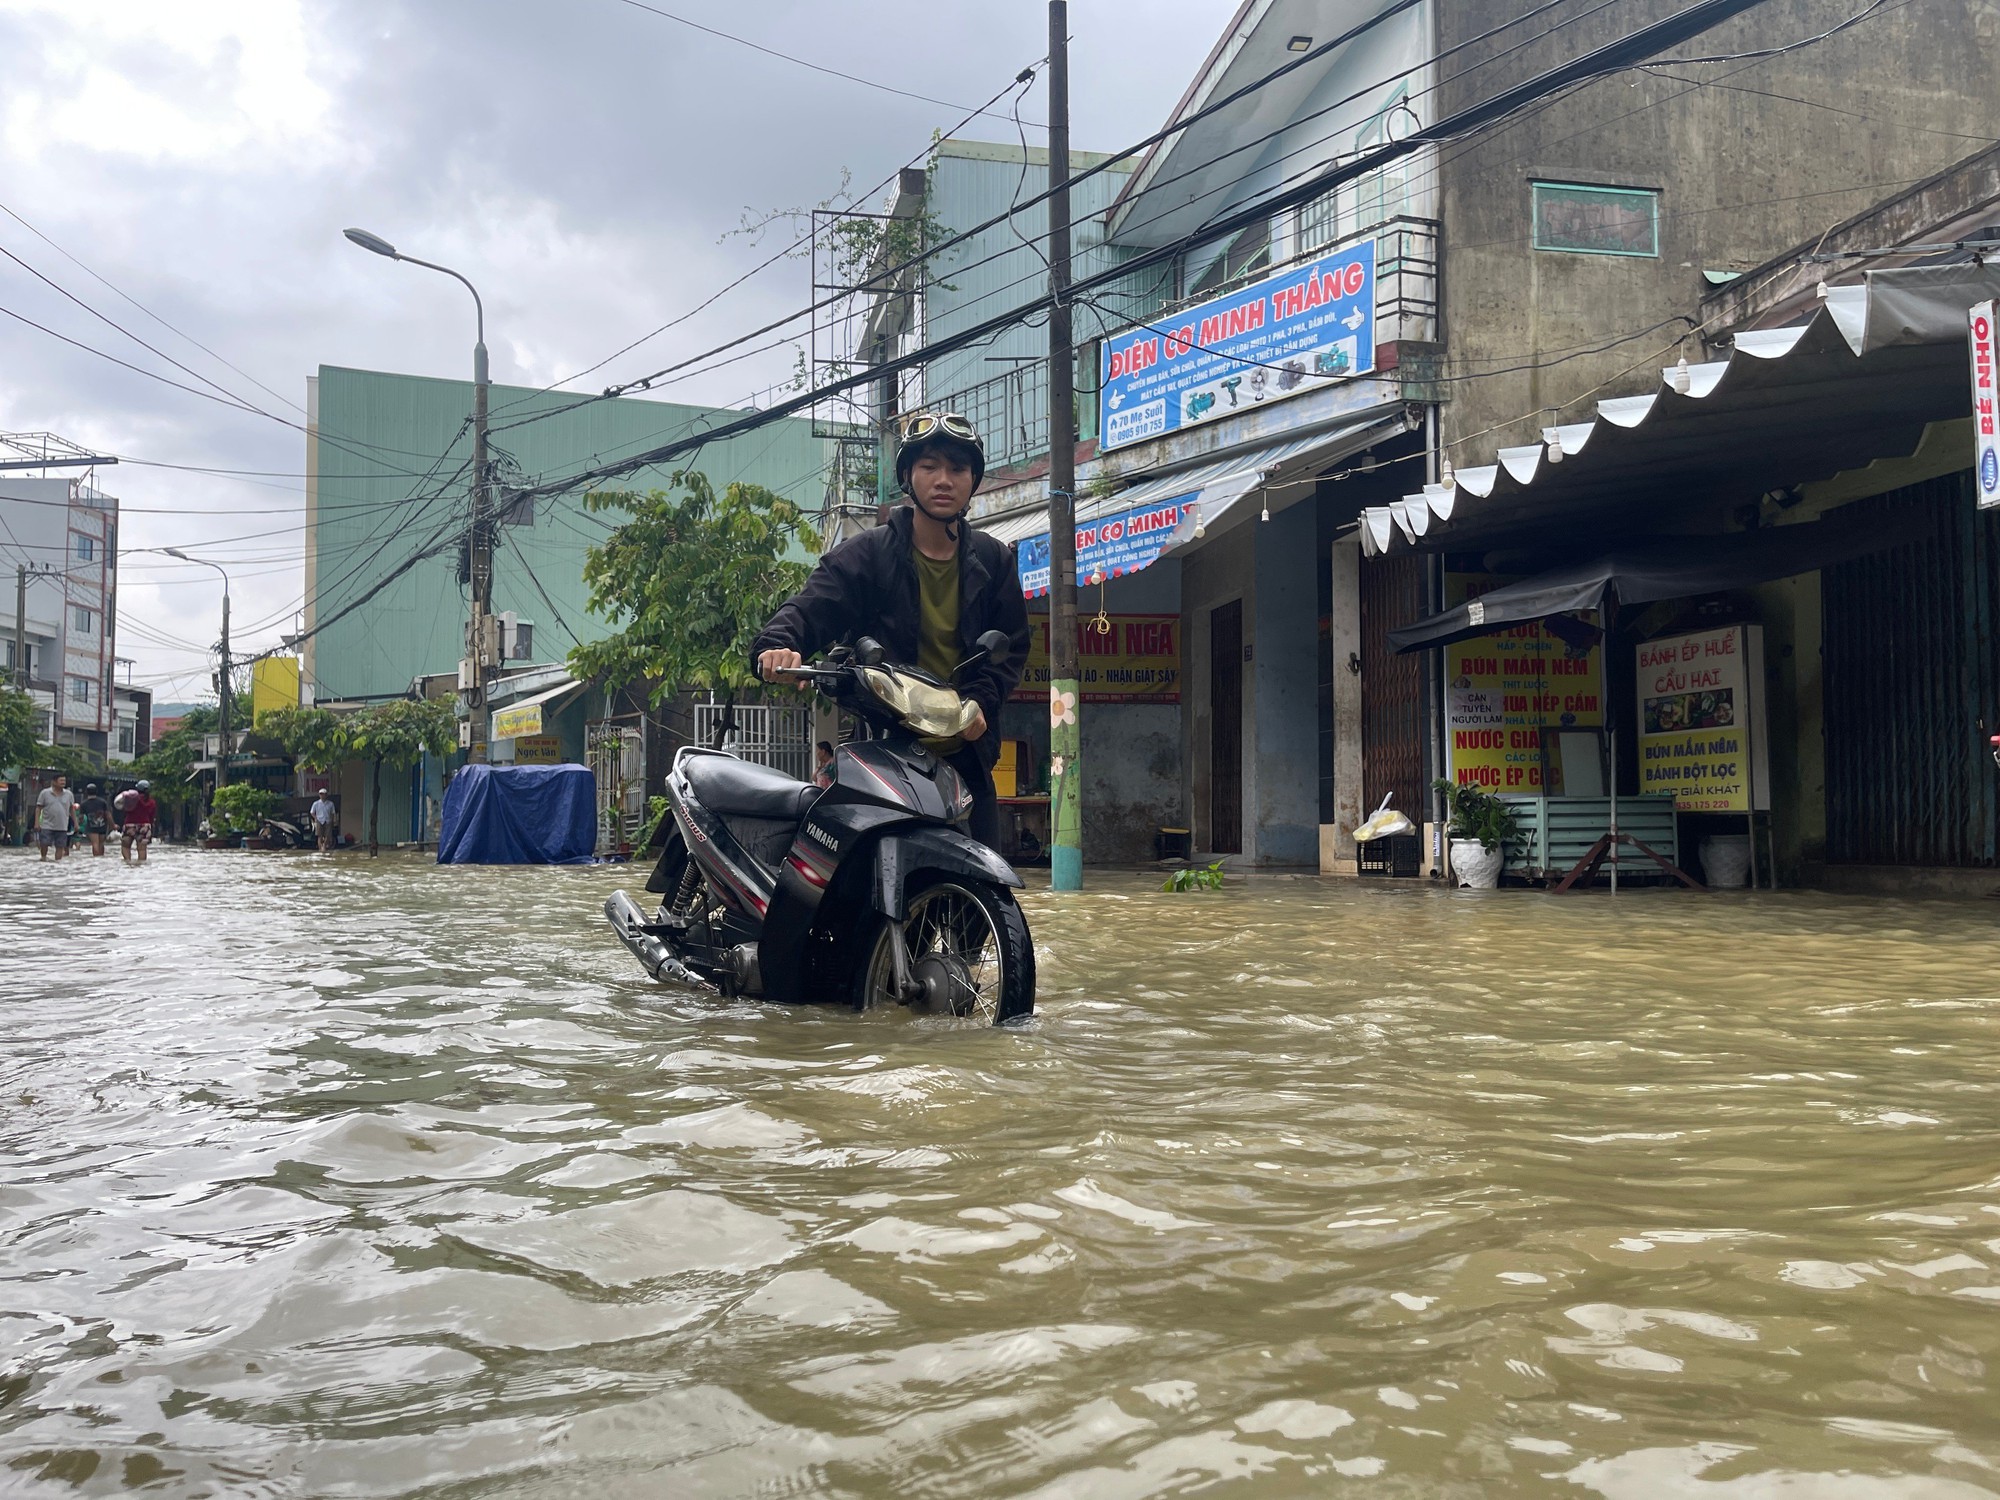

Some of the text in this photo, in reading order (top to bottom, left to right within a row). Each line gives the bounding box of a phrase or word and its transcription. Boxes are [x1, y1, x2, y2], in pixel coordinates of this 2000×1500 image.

[1107, 262, 1365, 381] ĐIỆN CƠ MINH THẮNG
[1119, 403, 1163, 428] 70 Mẹ Suốt
[1975, 397, 1994, 435] BÉ
[1118, 419, 1163, 441] 0905 910 755
[1076, 528, 1096, 553] ỆN
[1101, 520, 1126, 543] CƠ
[1127, 506, 1178, 537] MINH
[1041, 622, 1175, 656] TANH NGA
[1640, 628, 1738, 668] BÁNH ÉP HUẾ
[1461, 656, 1498, 675] BÚN
[1503, 653, 1546, 675] MẮM
[1024, 668, 1031, 682] &
[1085, 667, 1097, 683] ÁO
[1106, 667, 1134, 686] NHẬN
[1135, 667, 1155, 686] GIẶT
[1158, 667, 1177, 683] SẤY
[1690, 668, 1722, 688] HAI
[1468, 691, 1487, 702] CẦN
[1503, 695, 1528, 713] HUA
[1533, 690, 1561, 713] NẾP
[1452, 714, 1502, 724] NGƯỜI LÀM
[1505, 715, 1526, 725] NHÀ
[1455, 728, 1504, 750] NƯỚC
[1510, 726, 1540, 749] GIẢ
[1645, 736, 1738, 760] BÚN MẮM NÊM
[517, 747, 539, 758] Ngọc
[1505, 751, 1526, 763] CÁC
[1457, 764, 1501, 787] NƯỚC
[1506, 764, 1524, 786] ÉP
[1646, 761, 1737, 782] BÁNH BỘT LỌC
[1681, 784, 1704, 796] GIẢI
[1706, 783, 1741, 796] KHÁT
[1675, 800, 1729, 810] 935 175 220
[679, 804, 707, 842] Sirius
[806, 821, 839, 852] YAMAHA
